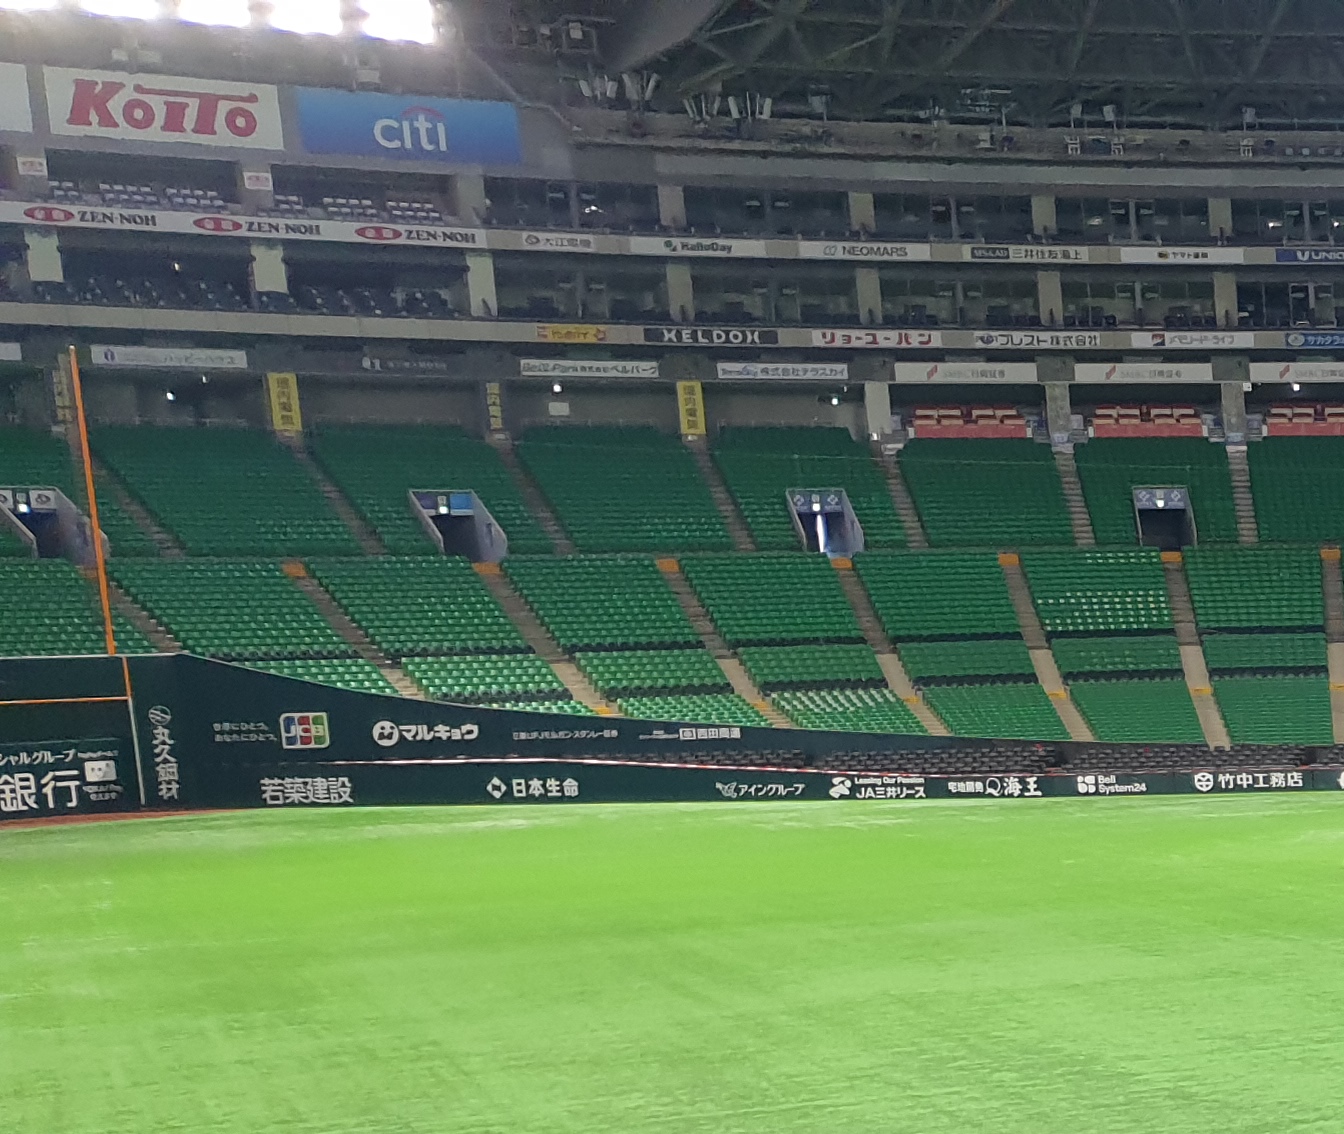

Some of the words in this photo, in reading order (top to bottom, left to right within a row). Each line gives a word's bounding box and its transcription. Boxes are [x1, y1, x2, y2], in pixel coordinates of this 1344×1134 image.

[373, 112, 448, 152] citi
[77, 210, 157, 227] ZEN-NOH
[245, 221, 321, 236] ZEN-NOH
[404, 229, 477, 245] ZEN-NOH
[821, 331, 932, 345] リョーユーパン
[400, 724, 480, 741] マルキョウ
[1002, 776, 1044, 797] 海王
[1098, 774, 1117, 784] Bell
[1217, 771, 1304, 789] 竹中工務店
[260, 776, 354, 804] 若築建設
[511, 777, 580, 798] 日本生命
[737, 782, 806, 797] アイングループ
[856, 786, 927, 800] JA三井リース
[1098, 783, 1148, 795] System24
